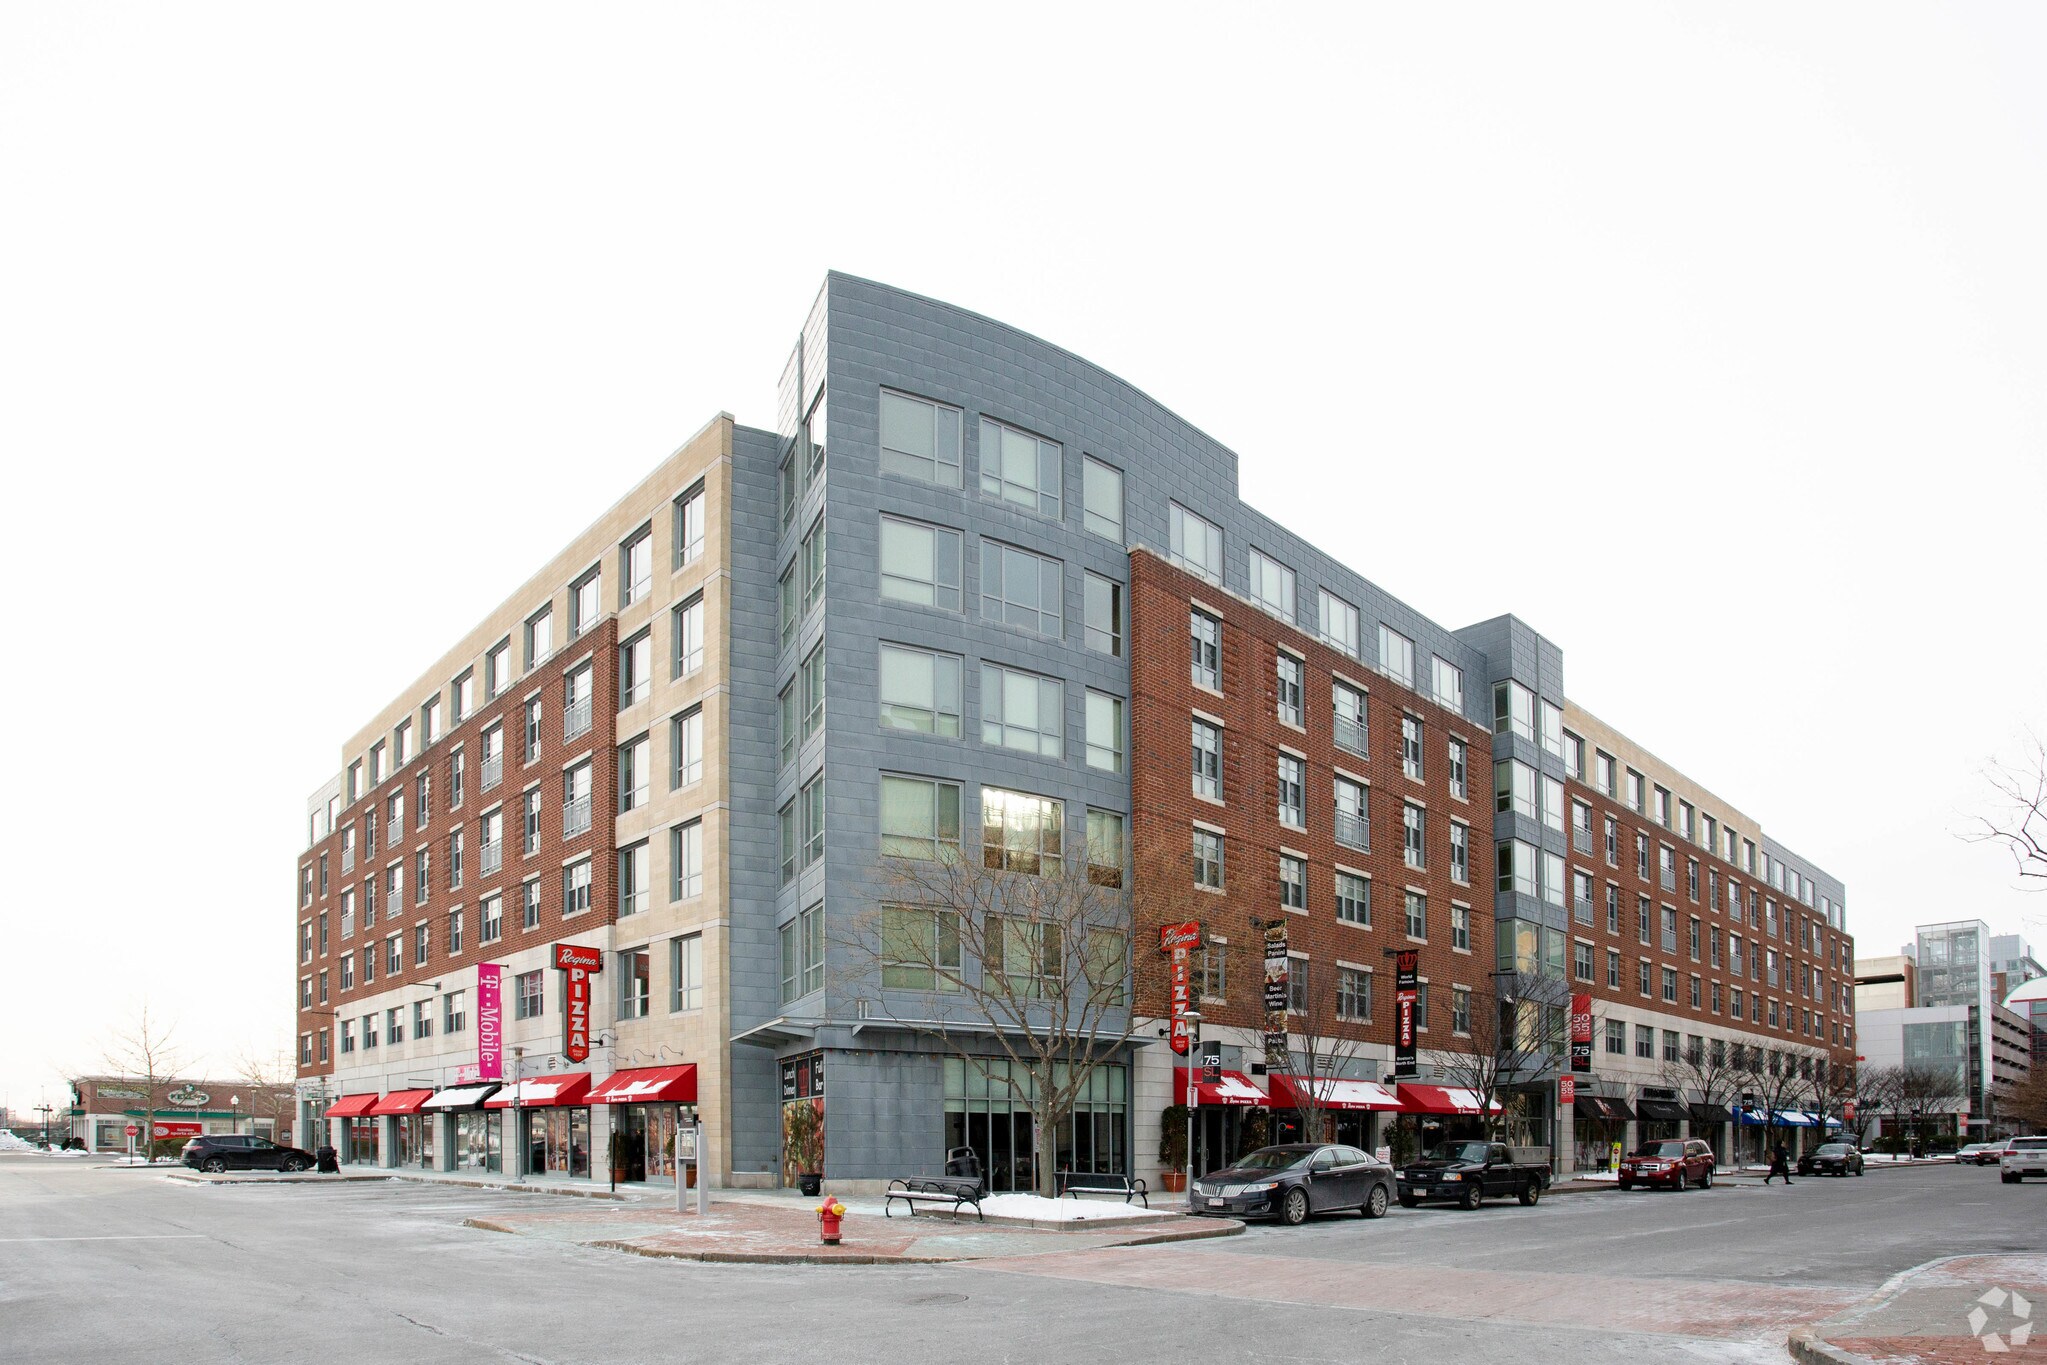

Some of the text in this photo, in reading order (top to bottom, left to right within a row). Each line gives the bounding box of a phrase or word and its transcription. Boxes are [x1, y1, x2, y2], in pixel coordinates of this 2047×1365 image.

[1164, 928, 1198, 946] Regina
[560, 948, 597, 966] Regina
[1174, 948, 1187, 1037] PIZZA
[1397, 992, 1416, 1001] Regina
[571, 968, 586, 1047] PIZZA
[1402, 1001, 1410, 1040] PIZZA
[1573, 1013, 1590, 1023] 50
[1573, 1023, 1590, 1032] 55
[1573, 1046, 1590, 1055] 75
[1204, 1056, 1220, 1065] 75
[1204, 1067, 1219, 1077] SL
[815, 1078, 823, 1091] Bar
[1561, 1080, 1573, 1088] 50
